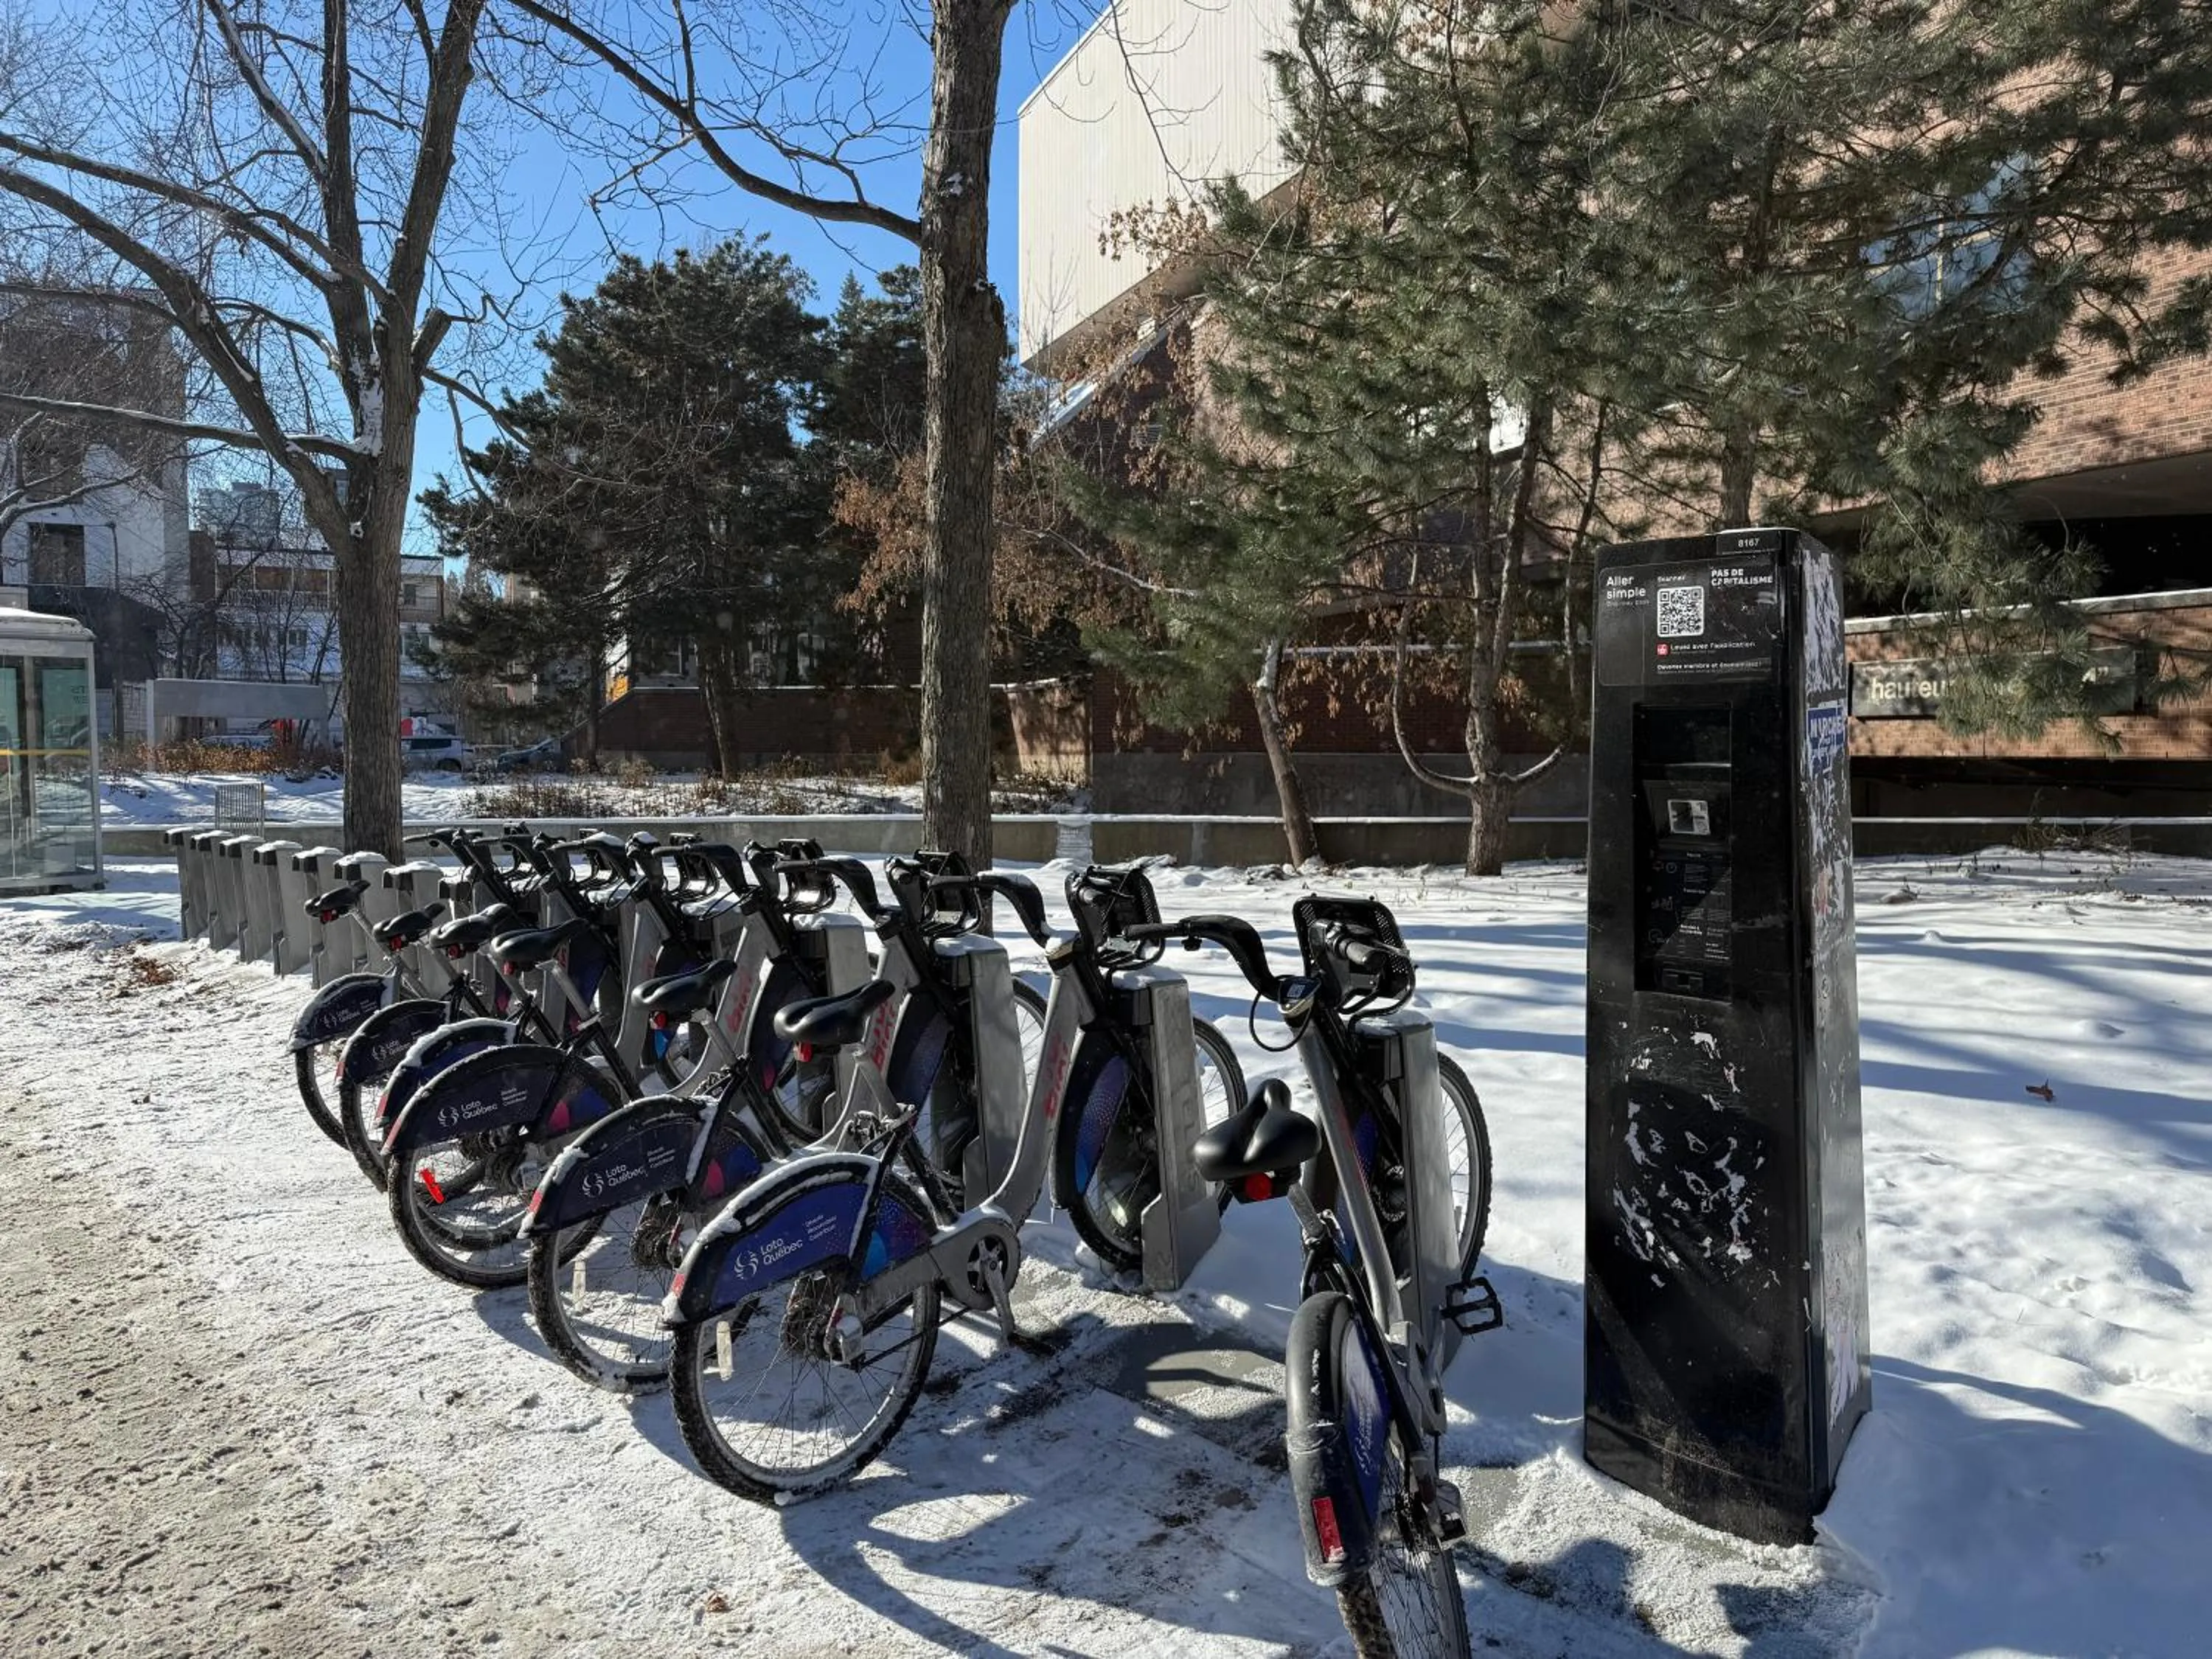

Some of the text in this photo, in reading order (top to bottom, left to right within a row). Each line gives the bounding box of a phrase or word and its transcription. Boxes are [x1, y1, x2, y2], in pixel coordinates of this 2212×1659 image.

[1738, 538, 1760, 548] 8167
[1711, 568, 1730, 577] PAS
[1606, 576, 1635, 586] Aller
[1607, 586, 1646, 599] simple
[1870, 675, 1956, 700] hauteu
[461, 1101, 481, 1112] Loto
[605, 1164, 626, 1178] Loto
[760, 1238, 784, 1256] Loto
[763, 1239, 803, 1265] Québec
